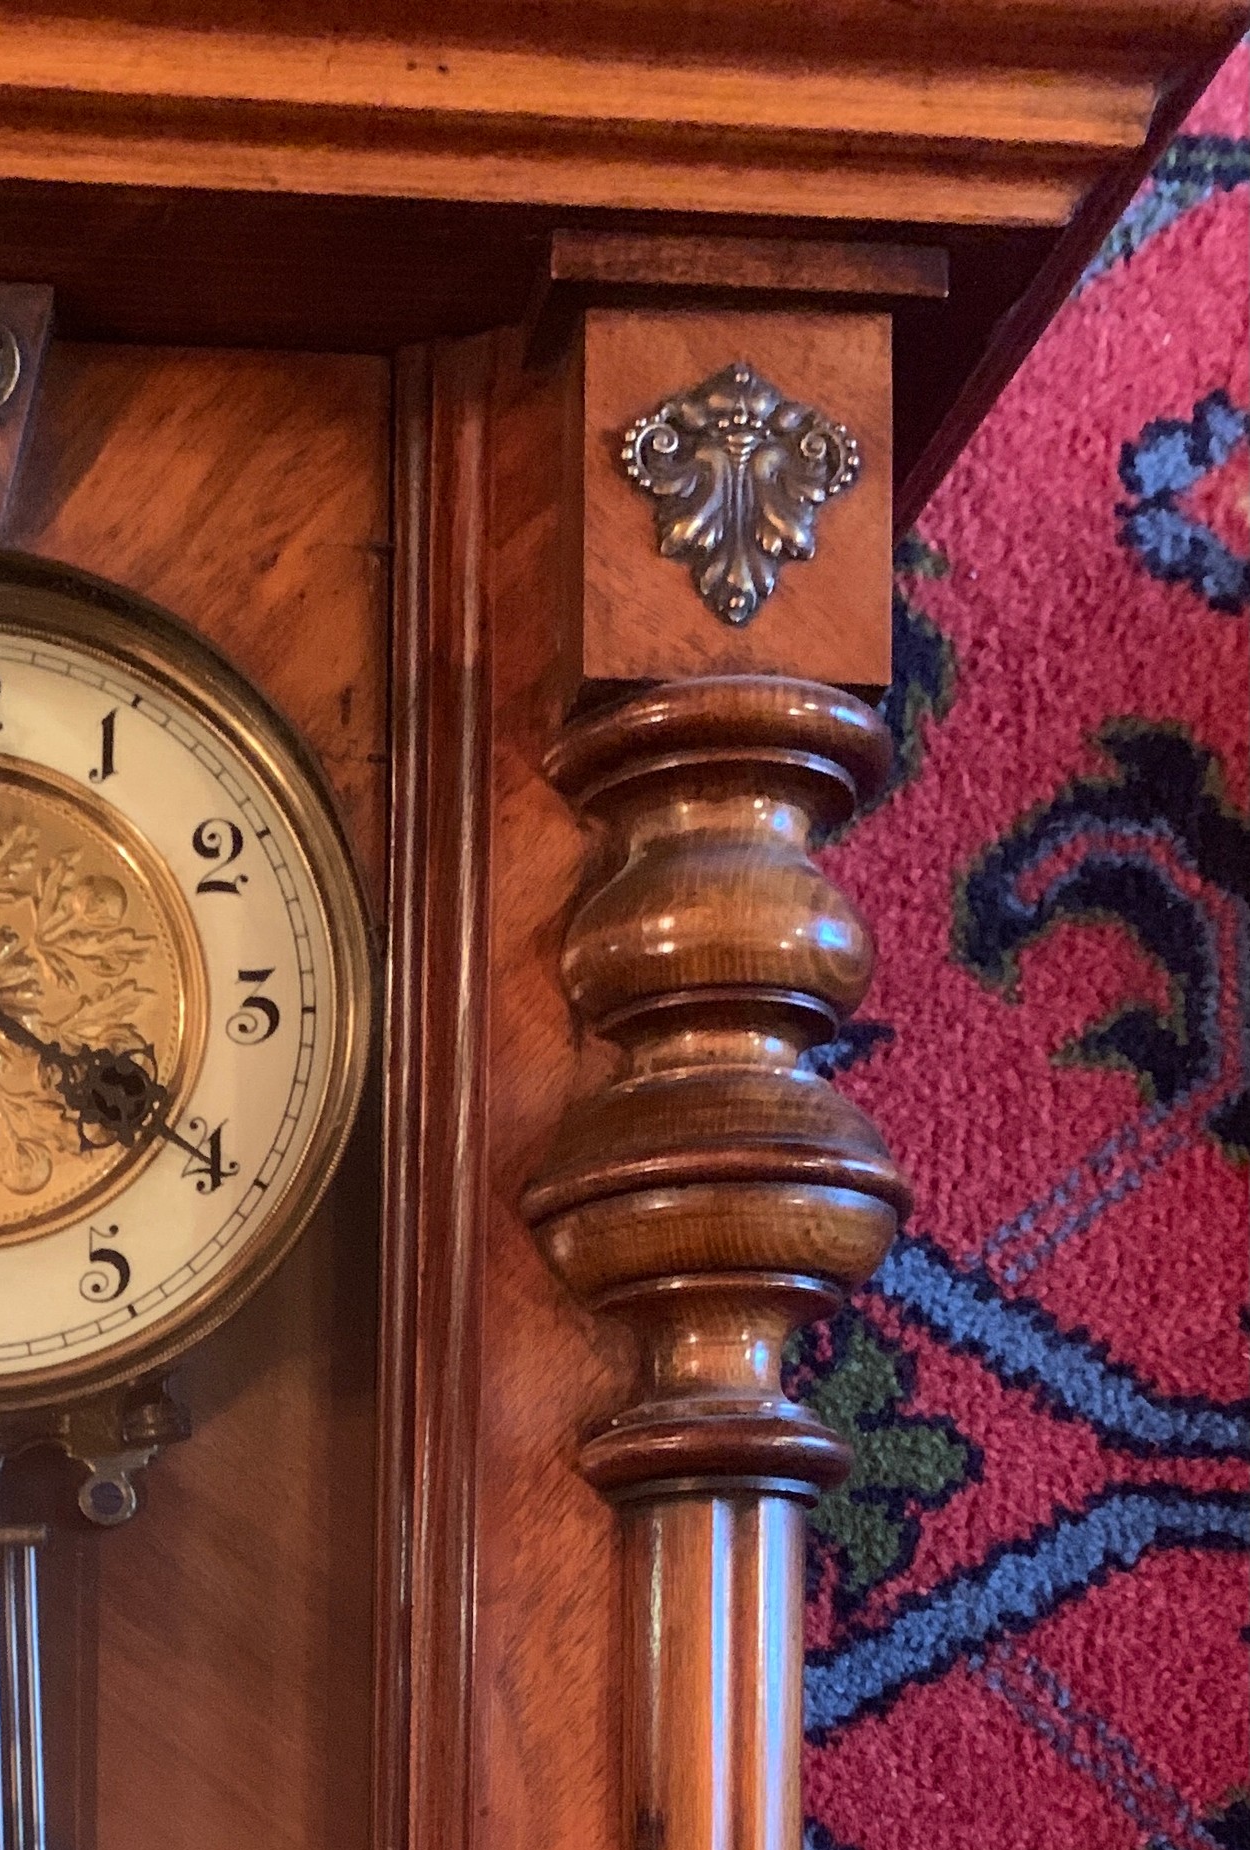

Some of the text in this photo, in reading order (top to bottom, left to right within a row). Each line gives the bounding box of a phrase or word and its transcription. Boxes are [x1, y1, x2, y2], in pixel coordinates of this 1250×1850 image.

[88, 707, 119, 783] 1
[192, 818, 248, 896] 2
[225, 968, 280, 1046] 3
[181, 1116, 240, 1195] 4
[79, 1224, 131, 1302] 5
